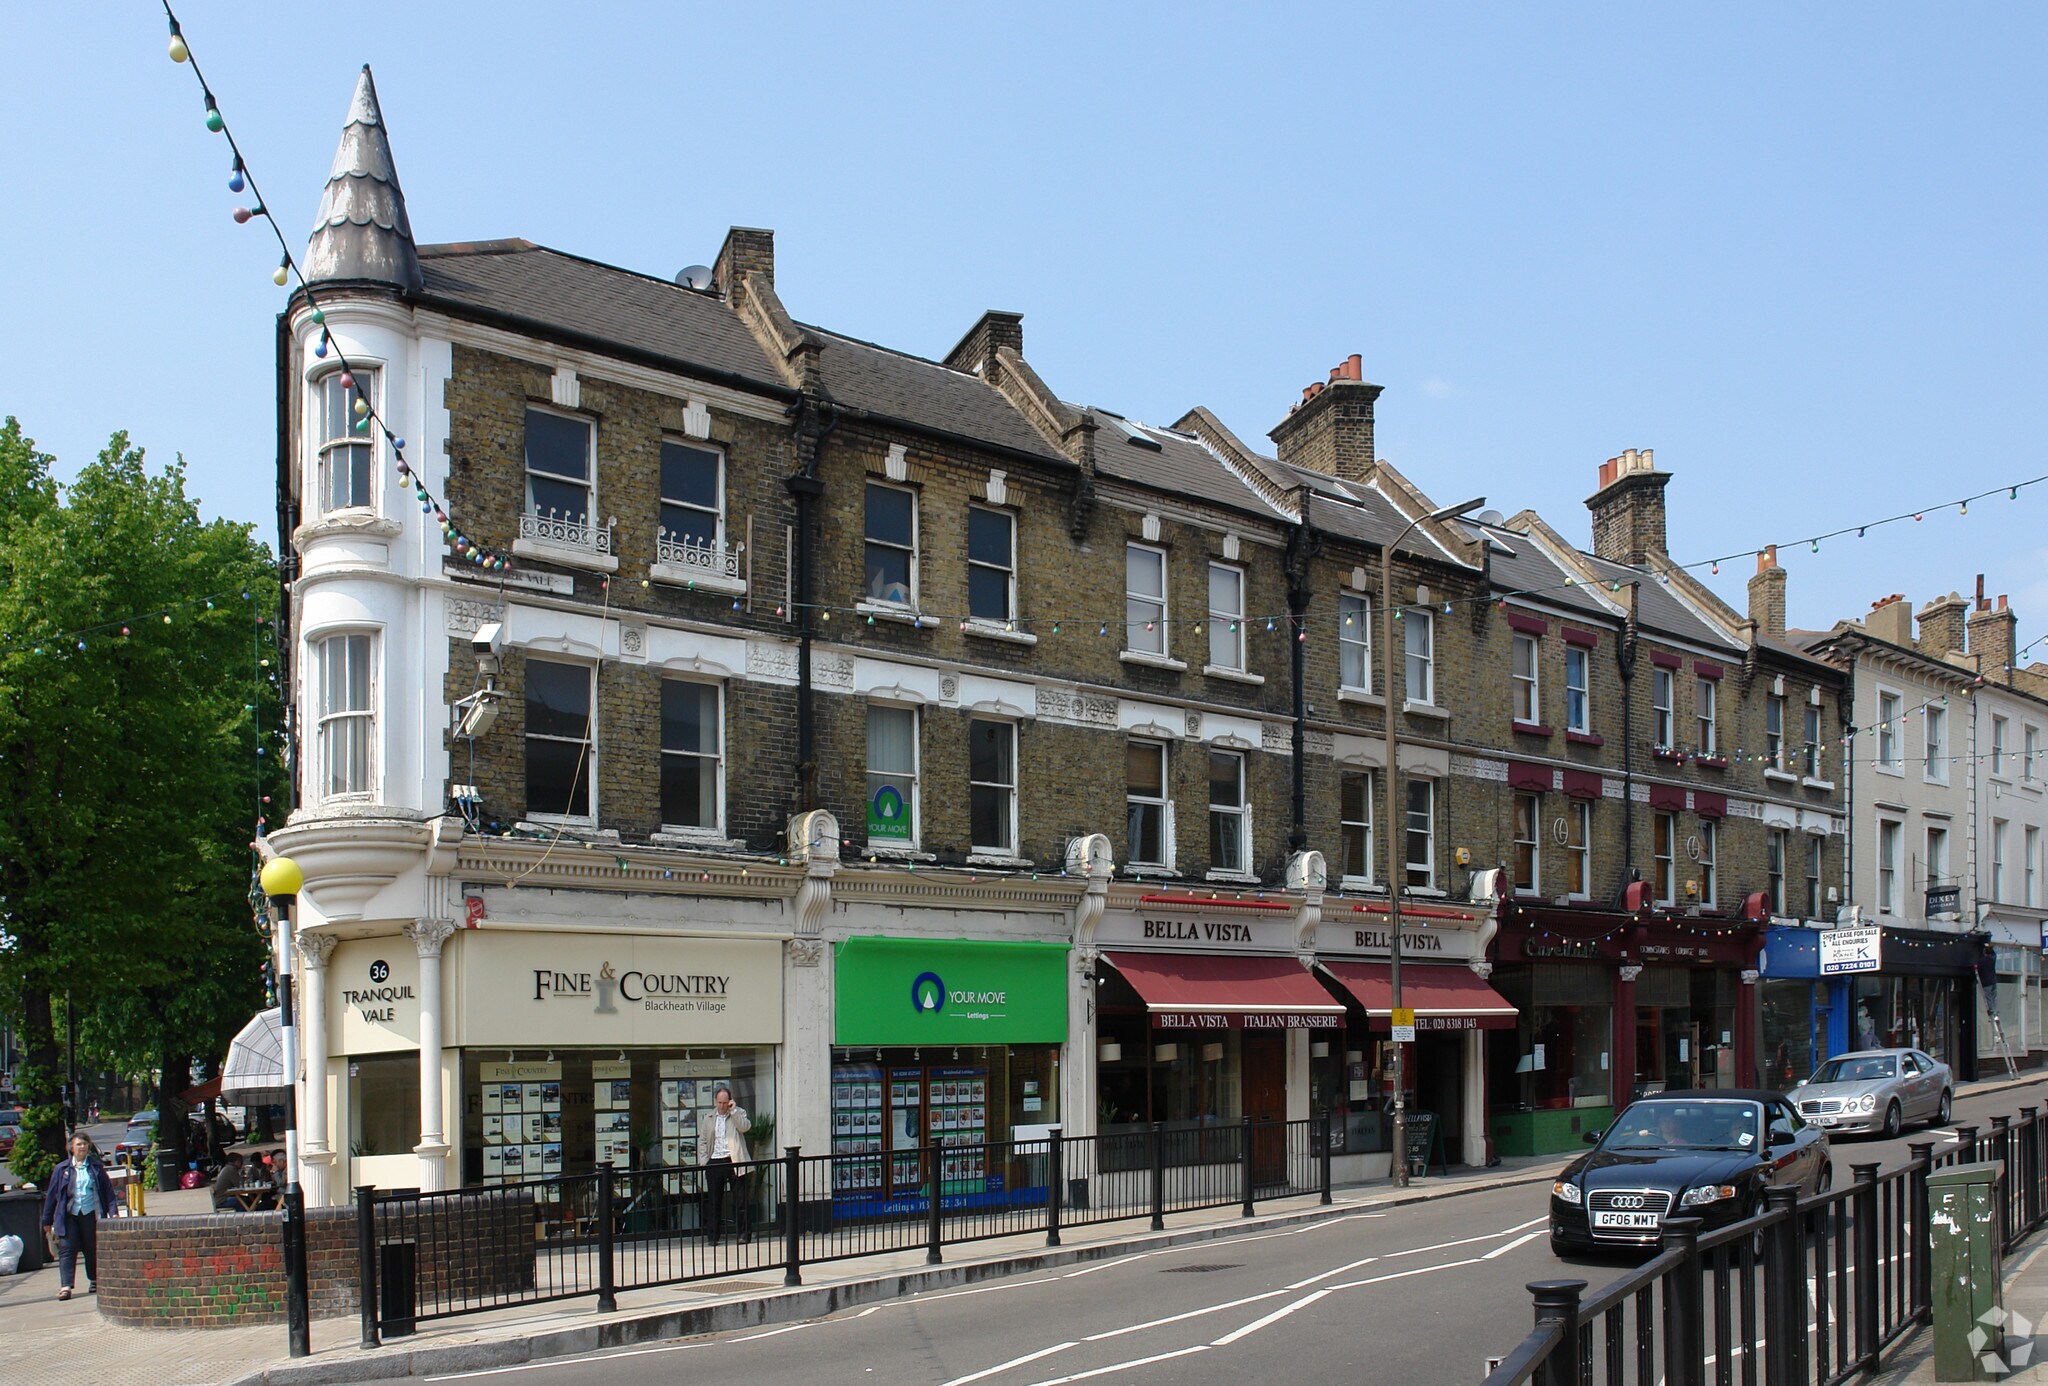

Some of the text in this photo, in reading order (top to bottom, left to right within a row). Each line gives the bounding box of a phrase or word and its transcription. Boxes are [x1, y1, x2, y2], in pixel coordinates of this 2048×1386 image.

[868, 823, 907, 834] YOUR MOVE
[1929, 894, 1956, 904] DIXEY
[1144, 920, 1252, 942] BELLA VISTA
[1837, 931, 1853, 939] LEASE
[1355, 931, 1442, 950] BELL VISTA
[372, 965, 388, 979] 36
[1826, 960, 1875, 972] 020 7224 0101
[533, 961, 730, 1001] FINE & COUNTRY
[342, 985, 416, 1004] TRANQUIL
[949, 991, 1006, 1004] YOUR MOVE
[645, 1000, 726, 1013] Blackheath Village
[362, 1007, 394, 1022] VALE
[967, 1012, 989, 1020] Lettings
[1160, 1014, 1338, 1028] BELLA VISTA ITALIAN BRASSERIE
[1433, 1017, 1445, 1029] 020
[517, 1067, 547, 1076] COUNTRY
[883, 1202, 915, 1214] Lettings
[1602, 1213, 1656, 1226] GF06 WMT
